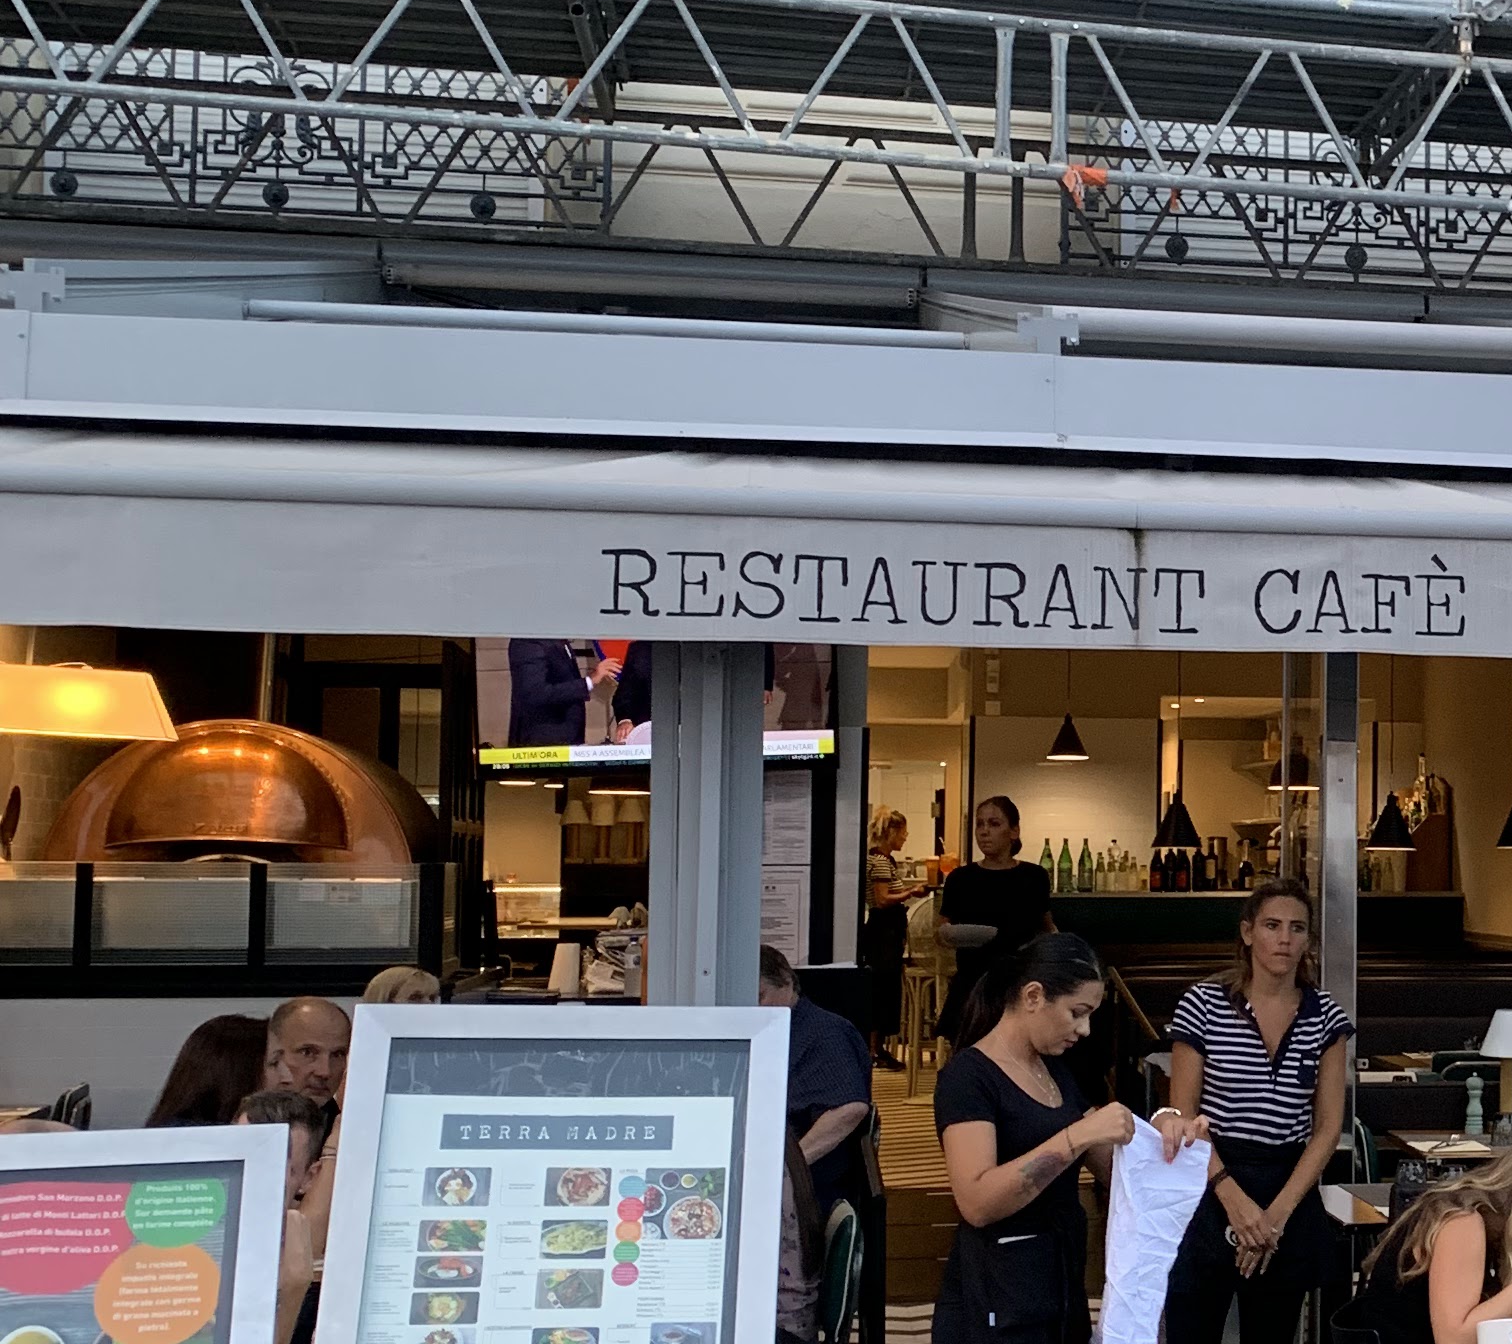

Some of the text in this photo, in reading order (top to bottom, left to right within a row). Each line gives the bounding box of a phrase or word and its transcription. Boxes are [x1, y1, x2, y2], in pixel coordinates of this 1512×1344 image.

[599, 548, 1467, 638] RESTAURANT CAFÈ
[460, 1125, 656, 1140] TERRA MADRE
